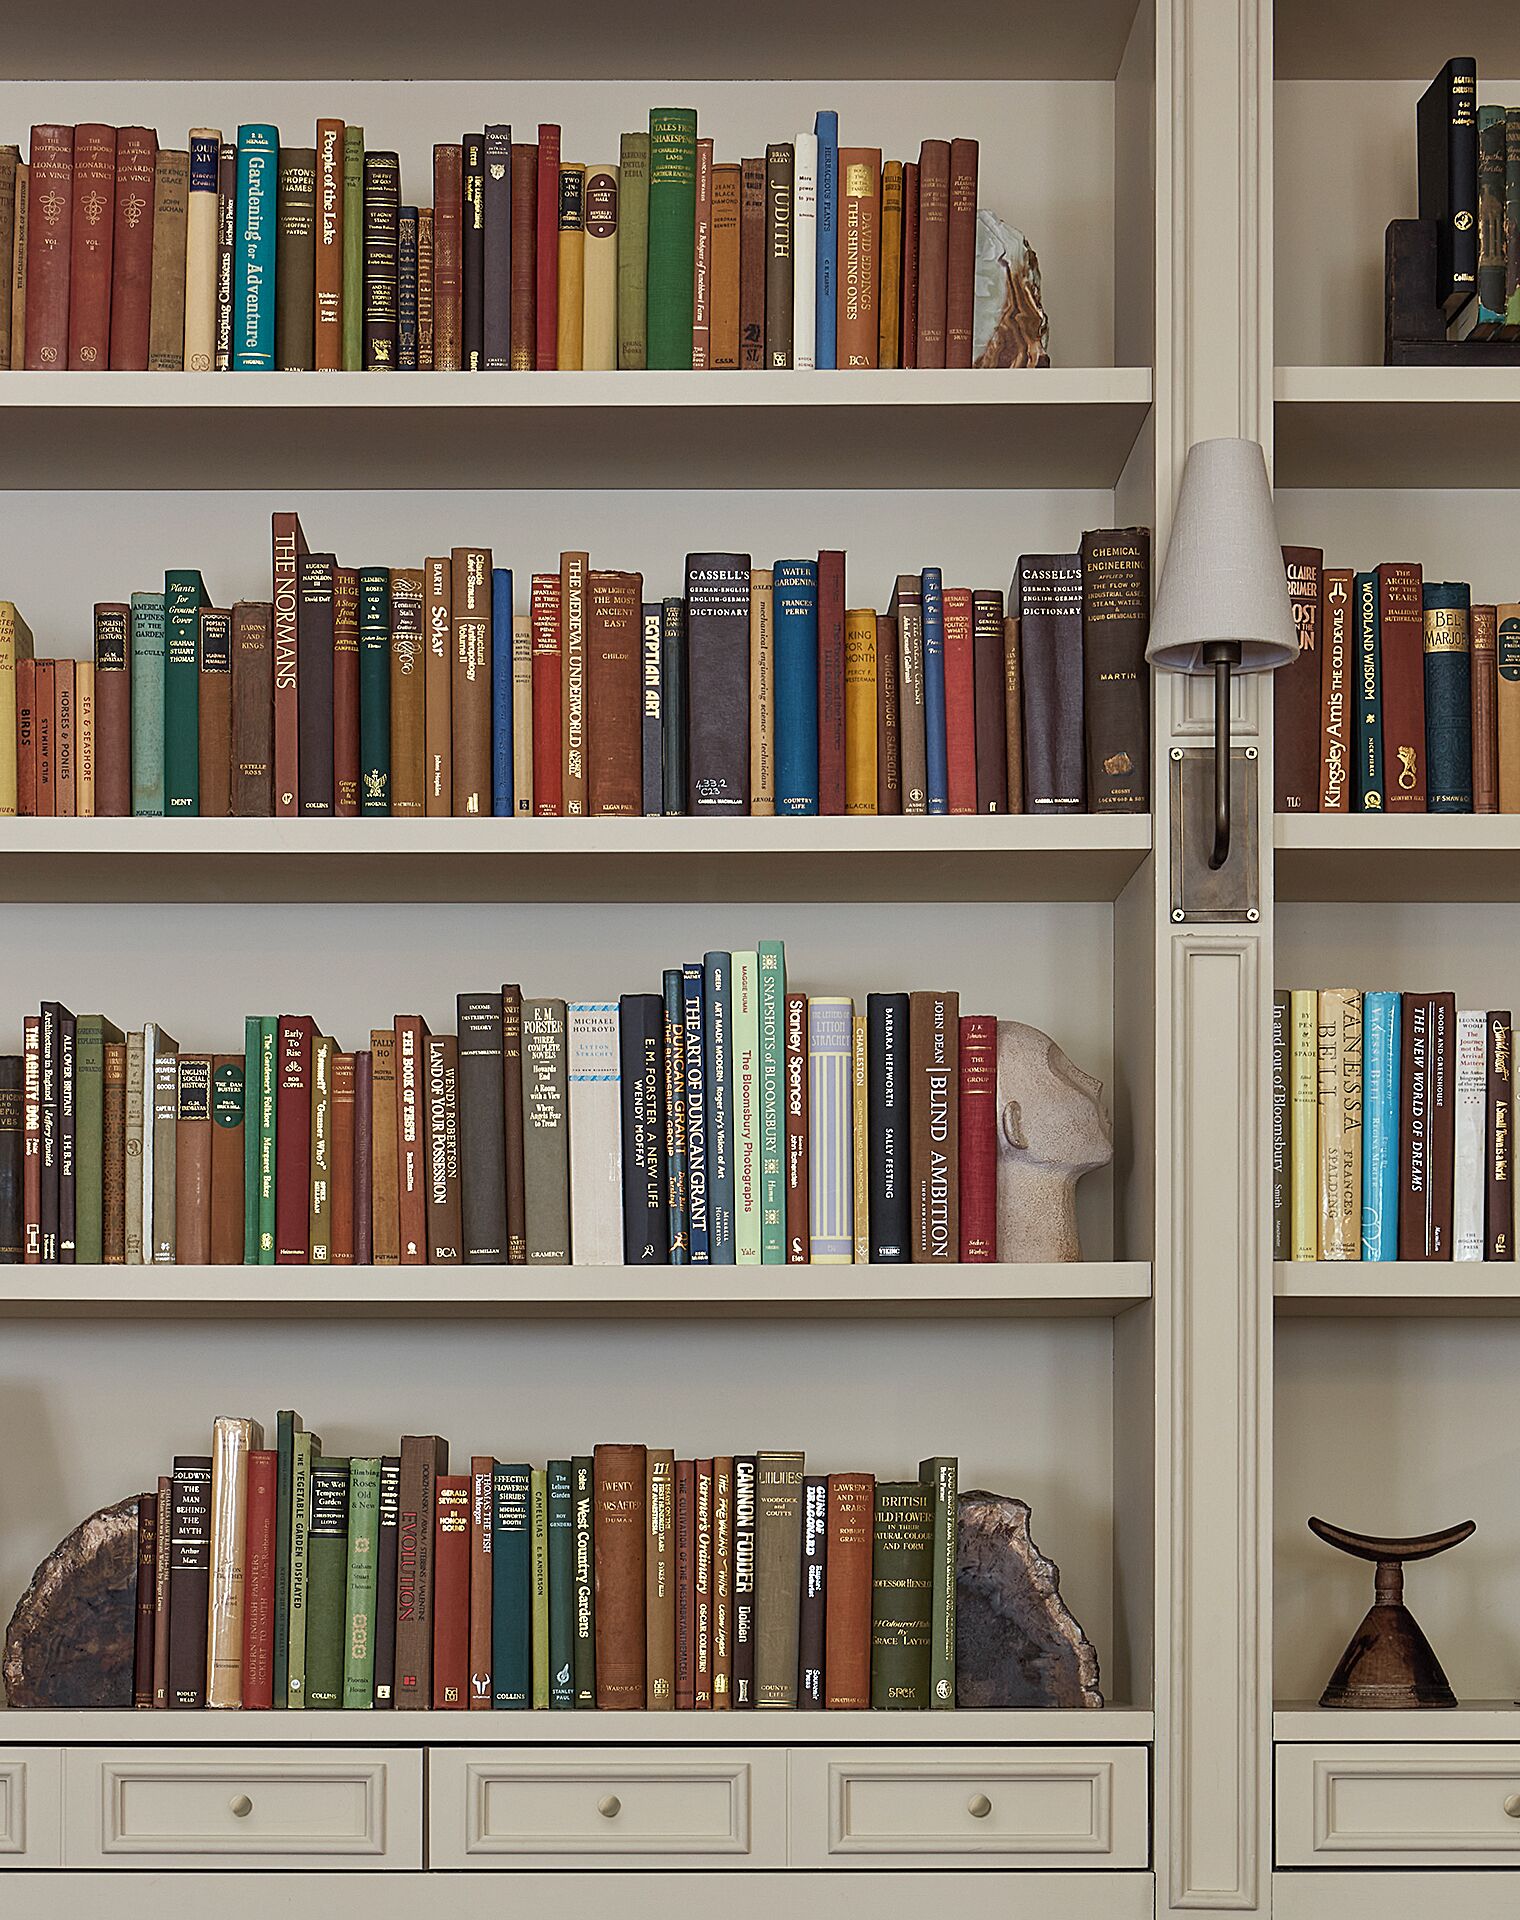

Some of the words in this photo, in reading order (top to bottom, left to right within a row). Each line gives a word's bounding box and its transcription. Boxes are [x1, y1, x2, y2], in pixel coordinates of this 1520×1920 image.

[196, 154, 212, 162] XIV
[322, 130, 336, 171] People
[324, 173, 335, 186] of
[245, 157, 265, 240] Gardening
[324, 187, 335, 210] the
[324, 212, 336, 245] Lake
[771, 180, 789, 258] JUDITH
[849, 202, 858, 229] THE
[863, 212, 871, 246] DAVID
[849, 230, 858, 284] SHINING
[219, 252, 230, 300] Chickens
[862, 250, 871, 310] EDDINGS
[1454, 273, 1474, 282] Collins
[246, 263, 263, 347] Adventure
[848, 286, 857, 320] ONES
[219, 303, 231, 350] Keeping
[276, 532, 295, 572] THE
[1093, 548, 1139, 557] CHEMICAL
[171, 584, 195, 592] Plants
[434, 563, 442, 595] BARTH
[569, 560, 581, 587] THE
[690, 571, 749, 580] CASSELL'S
[1288, 564, 1316, 580] CLAIRE
[177, 595, 188, 603] for
[334, 587, 359, 595] SIEGE
[135, 613, 164, 621] ALPINES
[172, 615, 192, 624] Cover
[335, 618, 357, 626] Kohima
[569, 590, 582, 654] MEDIEVAL
[1333, 609, 1343, 643] DEVILS
[1362, 582, 1373, 650] WOODLAND
[135, 630, 164, 638] GARDEN
[275, 578, 296, 689] NORMANS
[848, 631, 871, 639] KING
[645, 616, 660, 685] EGYPTIAN
[1333, 645, 1343, 667] OLD
[1332, 668, 1343, 690] THE
[1365, 651, 1375, 700] WISDOM
[569, 656, 581, 747] UNDERWORLD
[645, 690, 659, 719] ART
[1327, 694, 1342, 738] Amis
[22, 708, 30, 746] BIRDS
[696, 779, 727, 788] 433.2
[1325, 742, 1346, 807] Kingsley
[701, 788, 720, 796] C23
[524, 1021, 562, 1034] FORSTER
[686, 997, 700, 1030] THE
[764, 977, 775, 1049] SNAPSHOTS
[788, 1000, 803, 1052] Stanley
[935, 1001, 944, 1028] JOHN
[1274, 1005, 1286, 1018] In
[1413, 1008, 1424, 1032] THE
[285, 1030, 303, 1039] Early
[372, 1039, 395, 1047] TALLY
[645, 1039, 655, 1048] E.
[885, 1008, 893, 1050] BARBARA
[1274, 1021, 1286, 1046] and
[1460, 1039, 1484, 1047] Journey
[286, 1049, 301, 1057] Rise
[430, 1043, 444, 1078] LAND
[645, 1052, 655, 1065] M.
[672, 1024, 684, 1092] DUNCAN
[687, 1032, 701, 1066] ART
[742, 1050, 751, 1070] The
[765, 1052, 776, 1063] of
[935, 1032, 944, 1064] DEAN
[1274, 1052, 1282, 1071] out
[1413, 1037, 1424, 1067] NEW
[26, 1053, 39, 1101] AGILITY
[431, 1079, 443, 1092] OF
[445, 1068, 455, 1108] WENDY
[688, 1068, 702, 1089] OF
[787, 1057, 803, 1116] Spencer
[885, 1053, 893, 1107] HEPWORTH
[1274, 1076, 1286, 1091] of
[634, 1080, 644, 1121] WENDY
[645, 1068, 657, 1125] FORSTER
[741, 1075, 753, 1139] Bloomsbury
[764, 1064, 776, 1153] BLOOMSBURY
[930, 1077, 947, 1142] BLIND
[1412, 1071, 1424, 1118] WORLD
[26, 1105, 39, 1129] DOG
[432, 1094, 444, 1131] YOUR
[674, 1100, 686, 1156] GRANT
[446, 1111, 456, 1178] ROBERTSON
[635, 1125, 644, 1167] MOFFAT
[647, 1133, 656, 1142] A
[688, 1093, 704, 1170] DUNCAN
[885, 1128, 893, 1159] SALLY
[1273, 1092, 1286, 1172] Bloomsbury
[1412, 1122, 1423, 1137] OF
[433, 1134, 446, 1204] POSSESSION
[648, 1147, 657, 1178] NEW
[742, 1143, 753, 1212] Photographs
[1412, 1142, 1423, 1192] DREAMS
[648, 1183, 658, 1208] LIFE
[885, 1163, 893, 1198] FESTING
[1344, 1151, 1352, 1216] FRANCES
[691, 1172, 706, 1231] GRANT
[931, 1151, 948, 1257] AMBITION
[296, 1471, 304, 1518] VEGETABLE
[353, 1479, 376, 1487] Roses
[578, 1469, 586, 1491] Sales
[737, 1463, 754, 1526] CANNON
[176, 1506, 206, 1514] BEHIND
[535, 1492, 543, 1538] CAMELLIAS
[577, 1499, 590, 1529] West
[840, 1504, 865, 1512] ARABS
[883, 1497, 926, 1507] BRITISH
[179, 1527, 202, 1535] MYTH
[295, 1525, 303, 1557] GARDEN
[400, 1512, 417, 1621] EVOLUTION
[576, 1531, 590, 1584] Country
[736, 1532, 753, 1593] FODDER
[294, 1563, 303, 1609] DISPLAYED
[578, 1588, 590, 1638] Gardens
